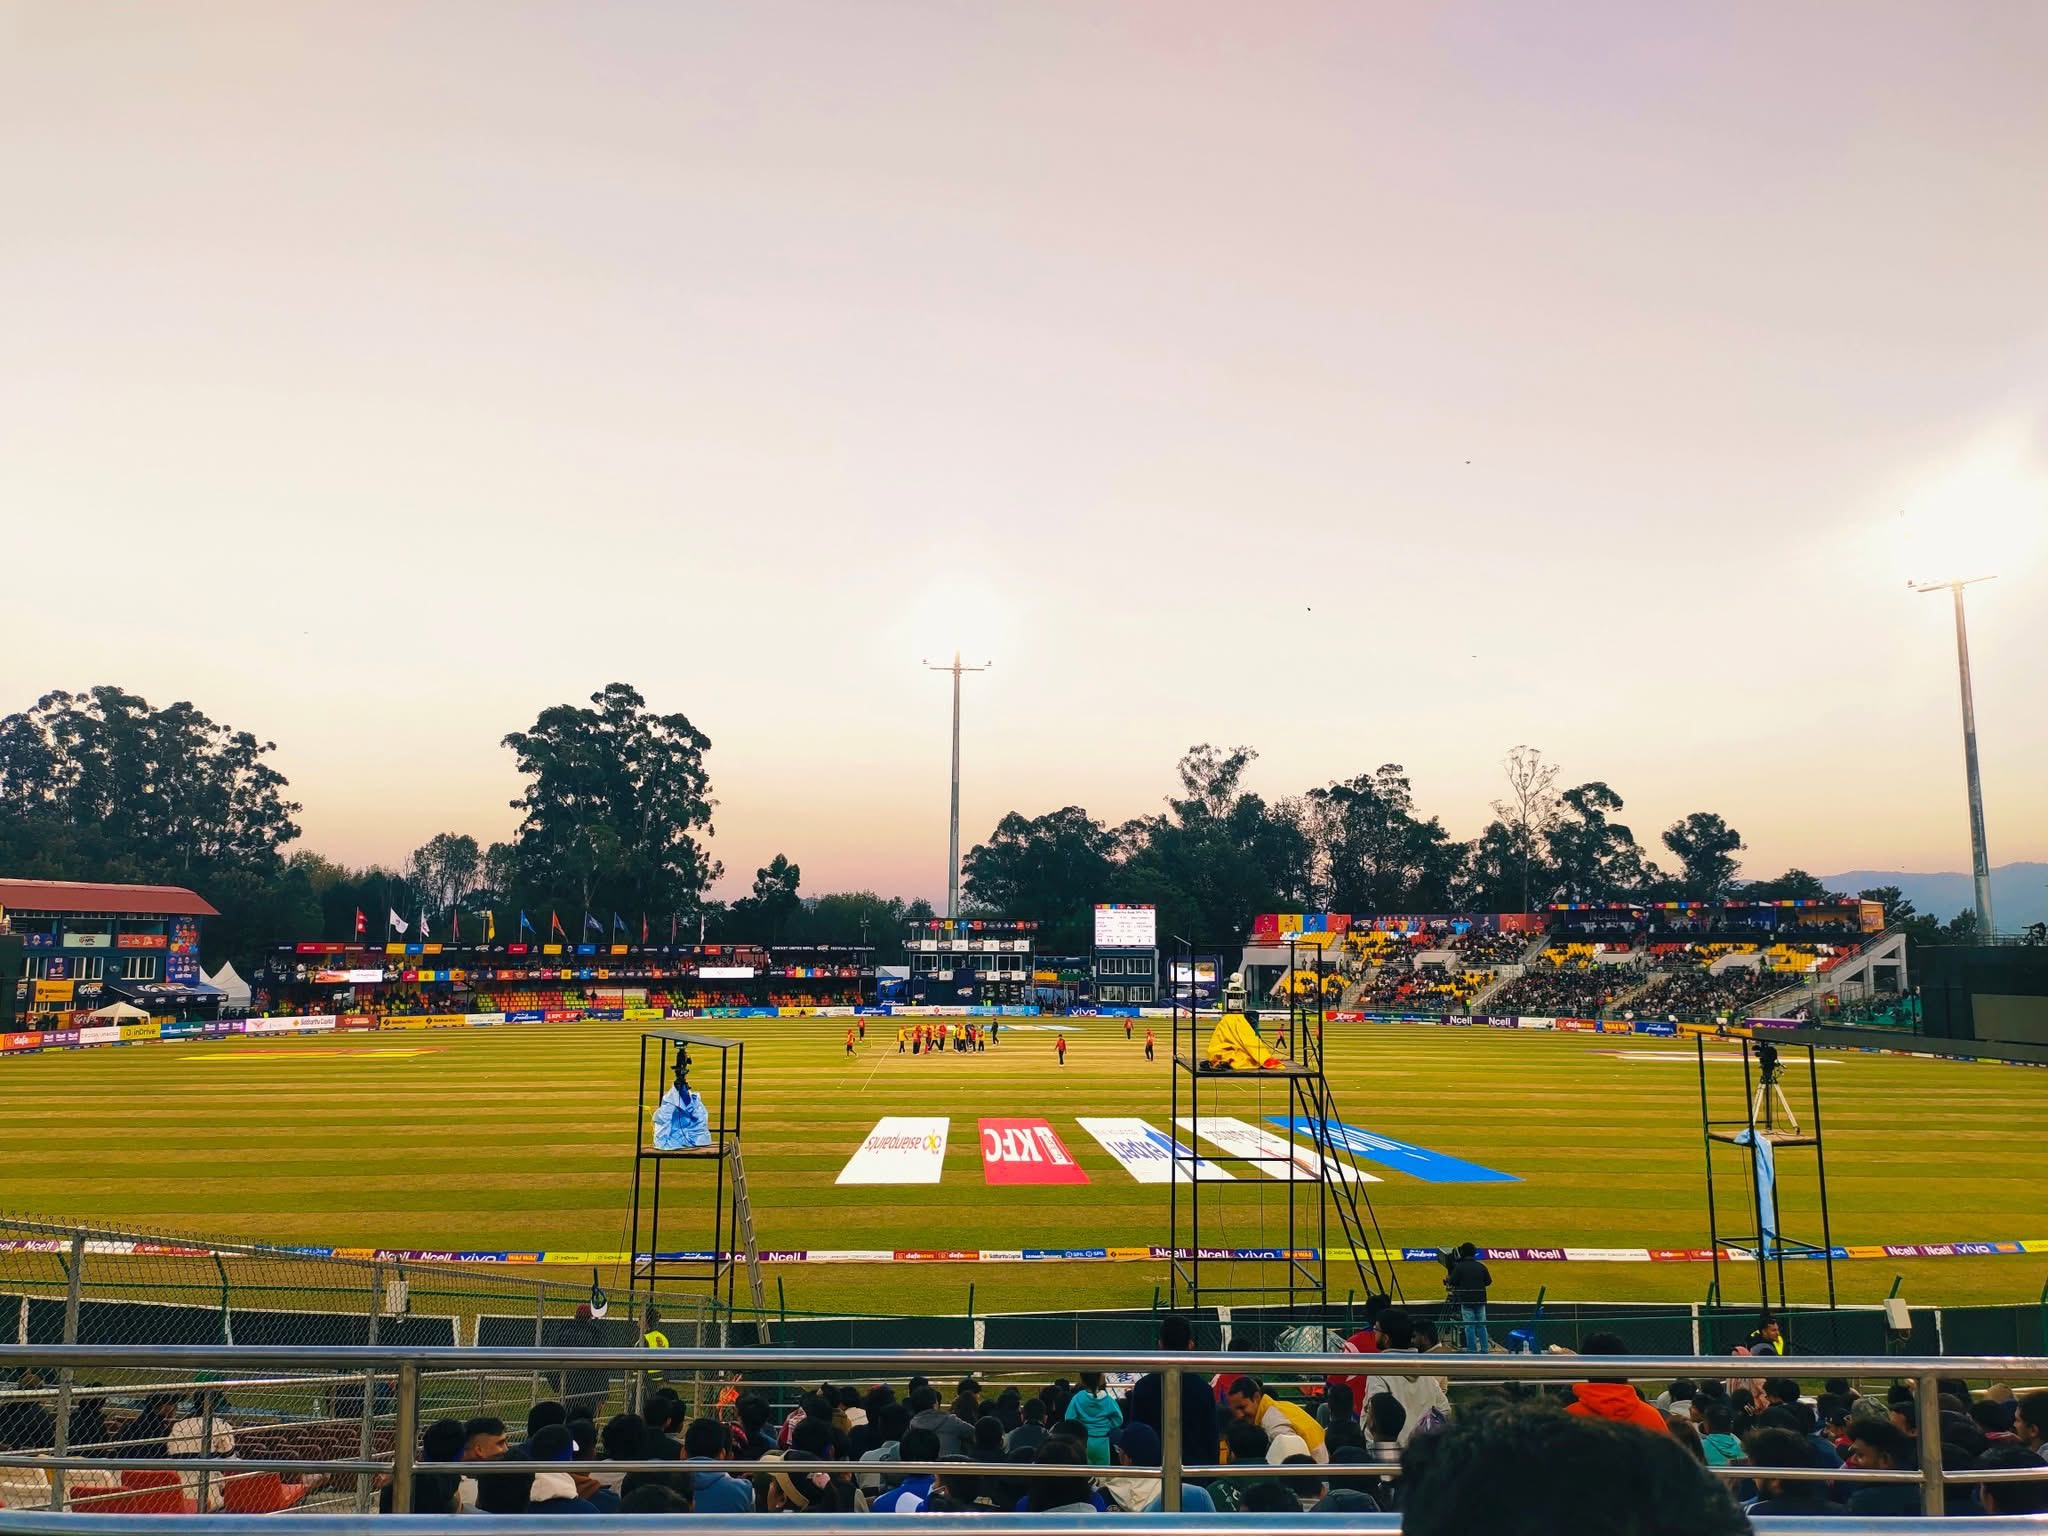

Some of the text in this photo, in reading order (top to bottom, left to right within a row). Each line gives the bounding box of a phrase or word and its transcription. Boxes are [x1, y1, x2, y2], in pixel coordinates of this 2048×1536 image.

[671, 1009, 694, 1017] Ncell
[1071, 1007, 1098, 1016] vivo
[1450, 1015, 1472, 1025] Ncell
[1488, 1016, 1511, 1026] Ncell
[867, 1131, 922, 1154] asianpaints
[983, 1127, 1043, 1162] KFC
[1106, 1138, 1169, 1164] expert
[24, 1241, 54, 1250] Ncell
[1925, 1245, 1953, 1256] Ncell
[1957, 1244, 1990, 1255] vivo
[1155, 1248, 1187, 1258] Ncell
[1198, 1249, 1229, 1259] Ncell
[1238, 1250, 1275, 1259] vivo
[1488, 1249, 1520, 1259] Ncell
[1529, 1249, 1561, 1259] Ncell
[1887, 1246, 1918, 1256] Ncell
[420, 1252, 452, 1261] Ncell
[460, 1253, 497, 1262] vivo
[769, 1252, 801, 1261] Ncell
